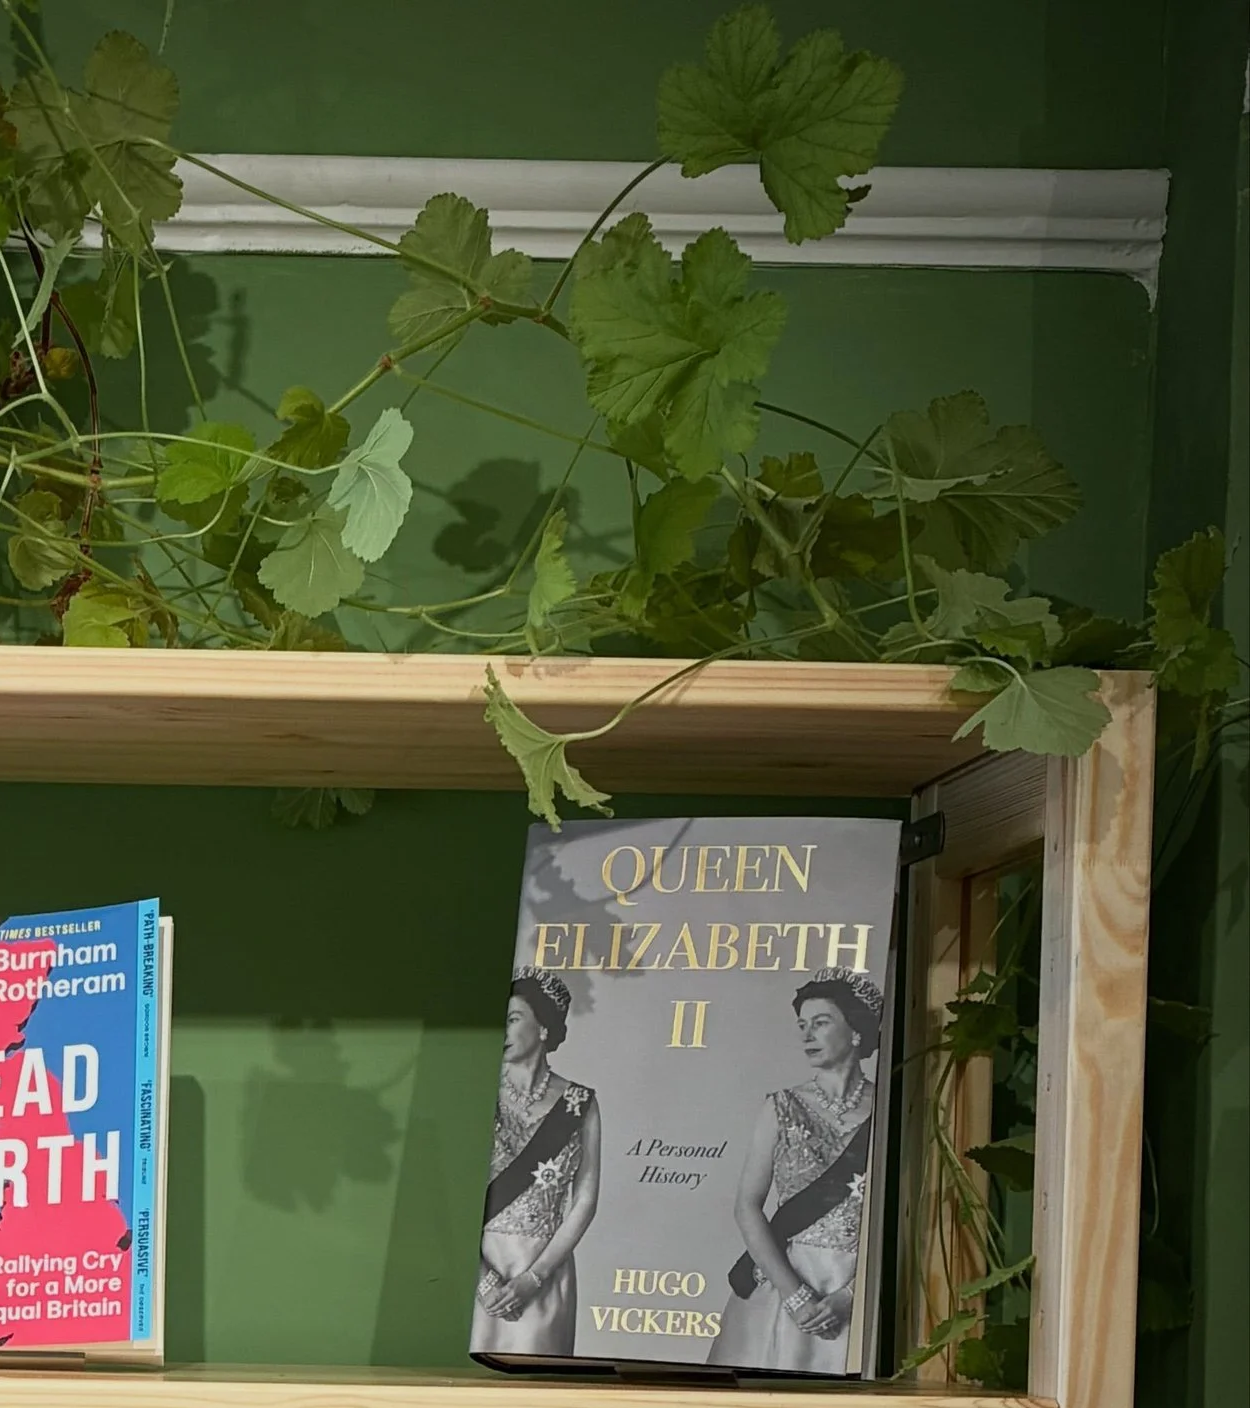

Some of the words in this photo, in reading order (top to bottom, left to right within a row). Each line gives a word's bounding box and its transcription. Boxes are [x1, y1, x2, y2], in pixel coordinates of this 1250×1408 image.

[601, 844, 817, 906] QUEEN
[0, 928, 31, 941] TIMES
[34, 920, 101, 938] BESTSELLER
[533, 922, 874, 974] ELIZABETH
[665, 1000, 711, 1049] II
[626, 1139, 643, 1156] A
[646, 1138, 728, 1159] Personal
[638, 1166, 707, 1190] History
[82, 1251, 123, 1272] Cry
[6, 1279, 39, 1297] for
[45, 1281, 59, 1295] a
[64, 1276, 122, 1295] More
[612, 1268, 706, 1298] HUGO
[47, 1299, 121, 1320] Britain
[590, 1306, 722, 1338] VICKERS
